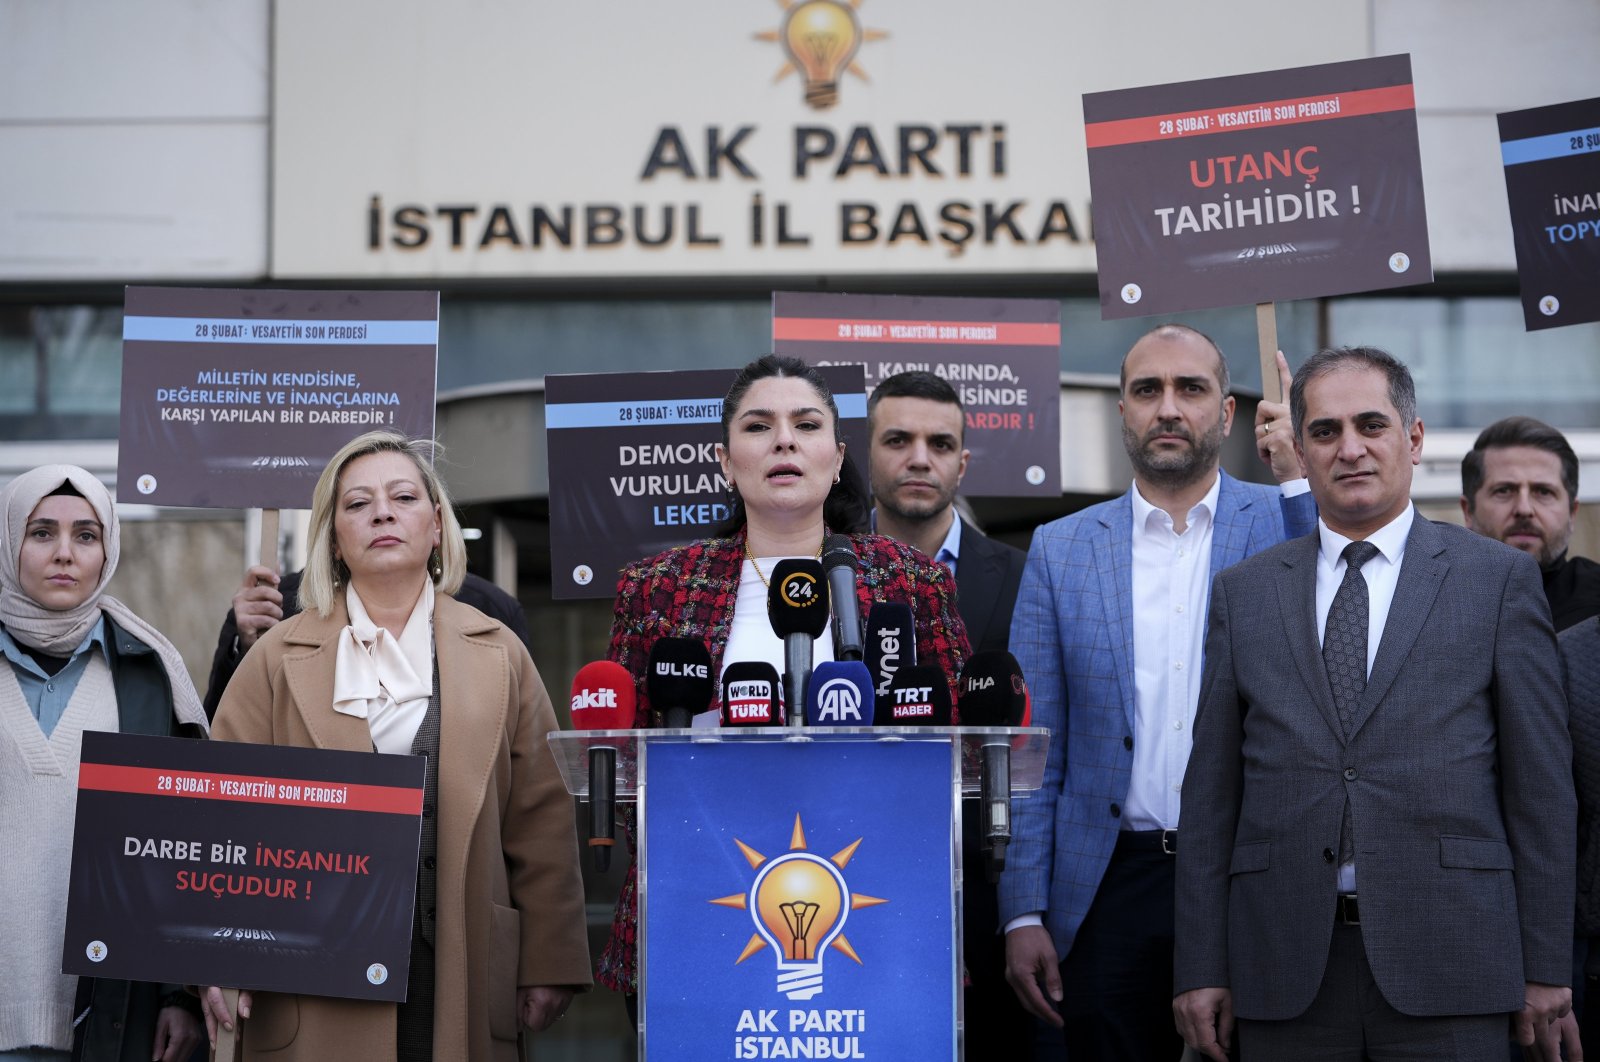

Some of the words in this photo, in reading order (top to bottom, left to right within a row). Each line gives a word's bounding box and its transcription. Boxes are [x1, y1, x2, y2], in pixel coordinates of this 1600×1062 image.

[1160, 121, 1173, 134] 28
[1176, 116, 1214, 135] ŞUBAT:
[1218, 106, 1272, 127] VESAYETİN
[1274, 104, 1296, 120] SON
[1298, 96, 1340, 117] PERDESİ
[640, 124, 758, 181] AK
[1570, 136, 1584, 150] 28
[1190, 146, 1320, 188] UTANÇ
[1154, 184, 1339, 236] TARİHİDİR
[367, 193, 720, 251] İSTANBUL
[750, 191, 810, 248] İL
[840, 200, 1095, 258] BAŞKA
[1237, 247, 1255, 258] 28
[1258, 243, 1297, 258] ŞUBAT
[195, 324, 208, 337] 28
[212, 325, 248, 340] ŞUBAT:
[252, 323, 302, 338] VESAYETİN
[305, 326, 325, 338] SON
[328, 324, 367, 339] PERDESİ
[890, 324, 938, 339] VESAYETİN
[939, 326, 958, 339] SON
[960, 325, 997, 340] PERDESİ
[198, 368, 267, 386] MİLLETİN
[272, 370, 360, 389] KENDİSİNE,
[156, 386, 261, 404] DEĞERLERİNE
[266, 391, 286, 404] VE
[290, 388, 400, 408] İNANÇLARINA
[161, 408, 205, 426] KARŞI
[210, 408, 276, 423] YAPILAN
[280, 407, 304, 423] BİR
[308, 408, 384, 424] DARBEDİR
[620, 408, 632, 420] 28
[636, 406, 672, 422] ŞUBAT:
[676, 402, 724, 419] VESAYETİ
[252, 456, 270, 466] 28
[272, 456, 310, 468] ŞUBAT
[610, 473, 728, 497] VURULAN
[653, 504, 734, 526] LEKED
[788, 581, 812, 598] 24
[876, 627, 900, 697] tvnet
[572, 688, 618, 711] akit
[730, 686, 769, 698] WORLD
[894, 687, 932, 704] TRT
[730, 704, 769, 718] TÜRK
[818, 690, 862, 721] AA
[894, 705, 932, 717] HABER
[157, 776, 172, 790] 28
[175, 776, 215, 794] ŞUBAT:
[220, 780, 276, 799] VESAYETİN
[278, 787, 301, 800] SON
[304, 787, 348, 804] PERDESİ
[124, 836, 202, 861] DARBE
[210, 840, 247, 865] BİR
[256, 842, 370, 875] İNSANLIK
[176, 870, 297, 899] SUÇUDUR
[213, 926, 234, 938] 28
[236, 928, 276, 941] ŞUBAT
[736, 1009, 778, 1032] AK
